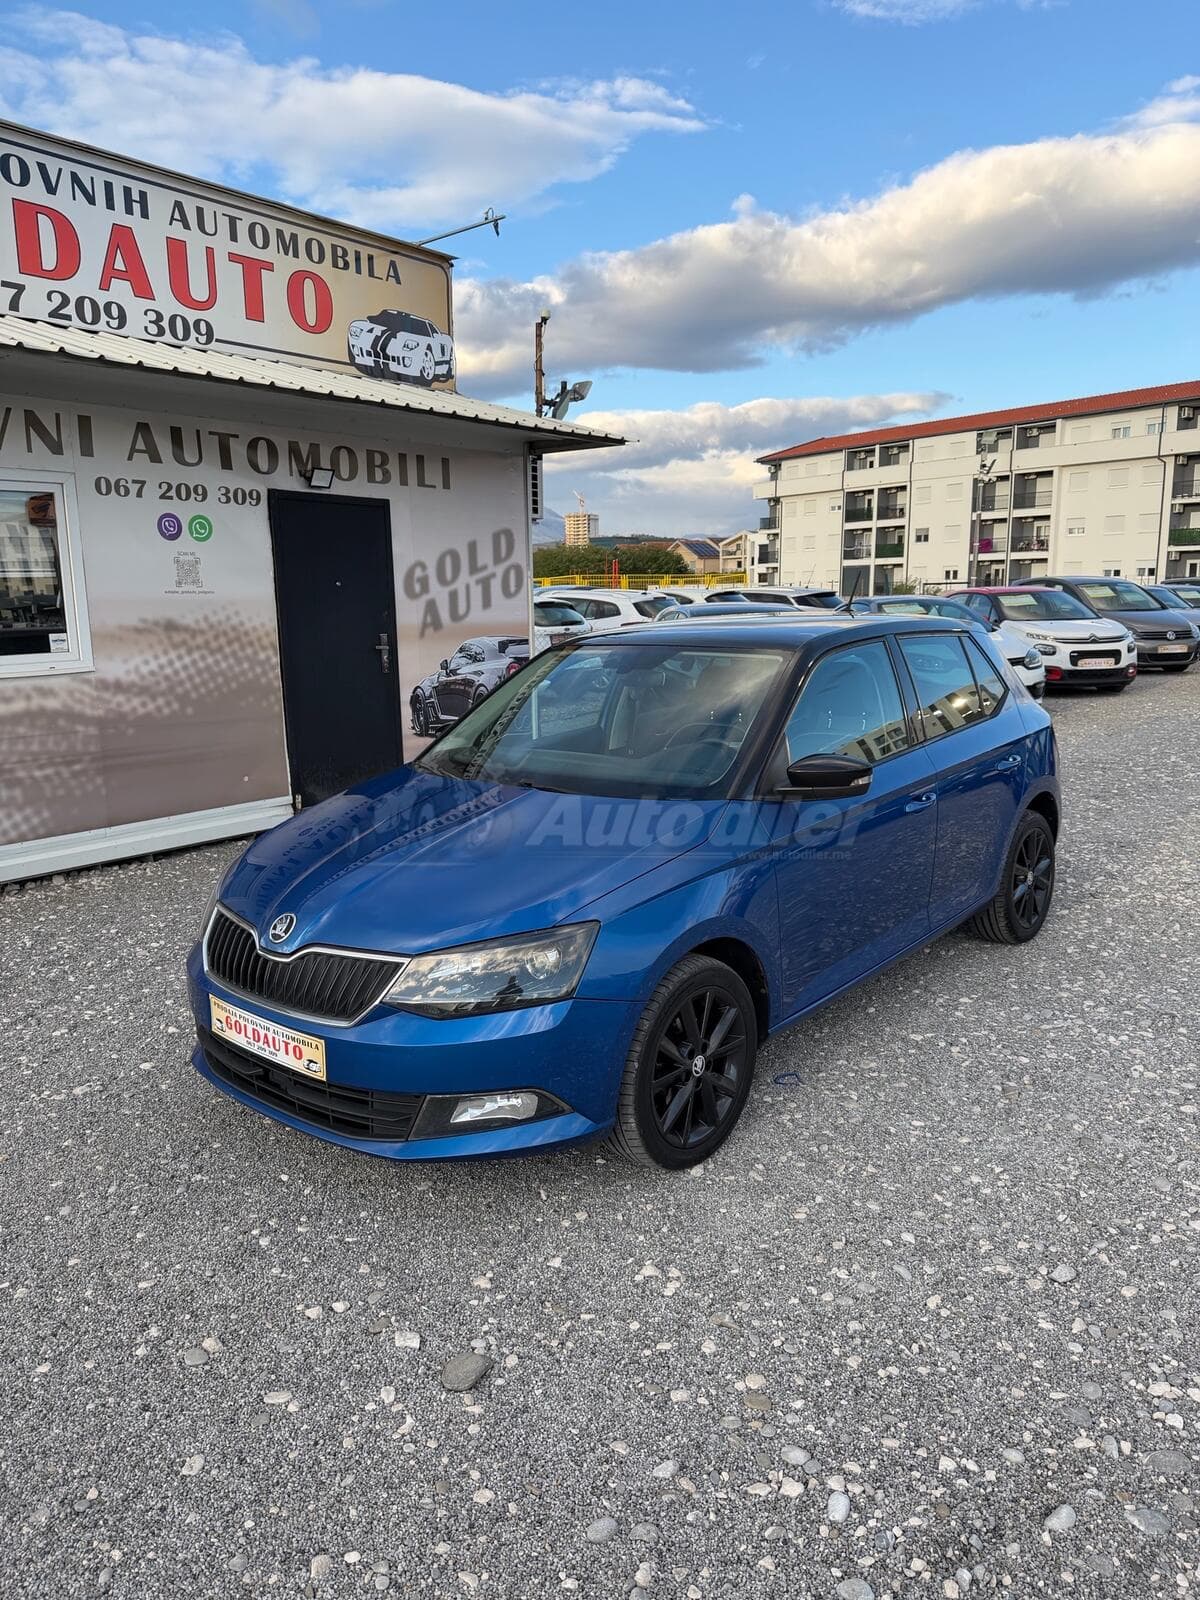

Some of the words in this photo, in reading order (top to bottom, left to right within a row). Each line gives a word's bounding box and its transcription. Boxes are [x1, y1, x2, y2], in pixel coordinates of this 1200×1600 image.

[0, 153, 150, 220] OVNIH
[168, 199, 402, 285] AUTOMOBILA
[12, 197, 333, 334] DAUTO
[0, 279, 26, 313] 7
[46, 289, 128, 330] 209
[143, 308, 215, 346] 309
[126, 421, 451, 490] AUTOMOBILI
[94, 475, 147, 499] 067
[157, 480, 209, 503] 209
[217, 485, 262, 507] 309
[403, 527, 516, 602] GOLD
[419, 561, 524, 639] AUTO
[225, 1014, 303, 1061] GOLDAUTO
[272, 1028, 320, 1051] AUTOMOBILA
